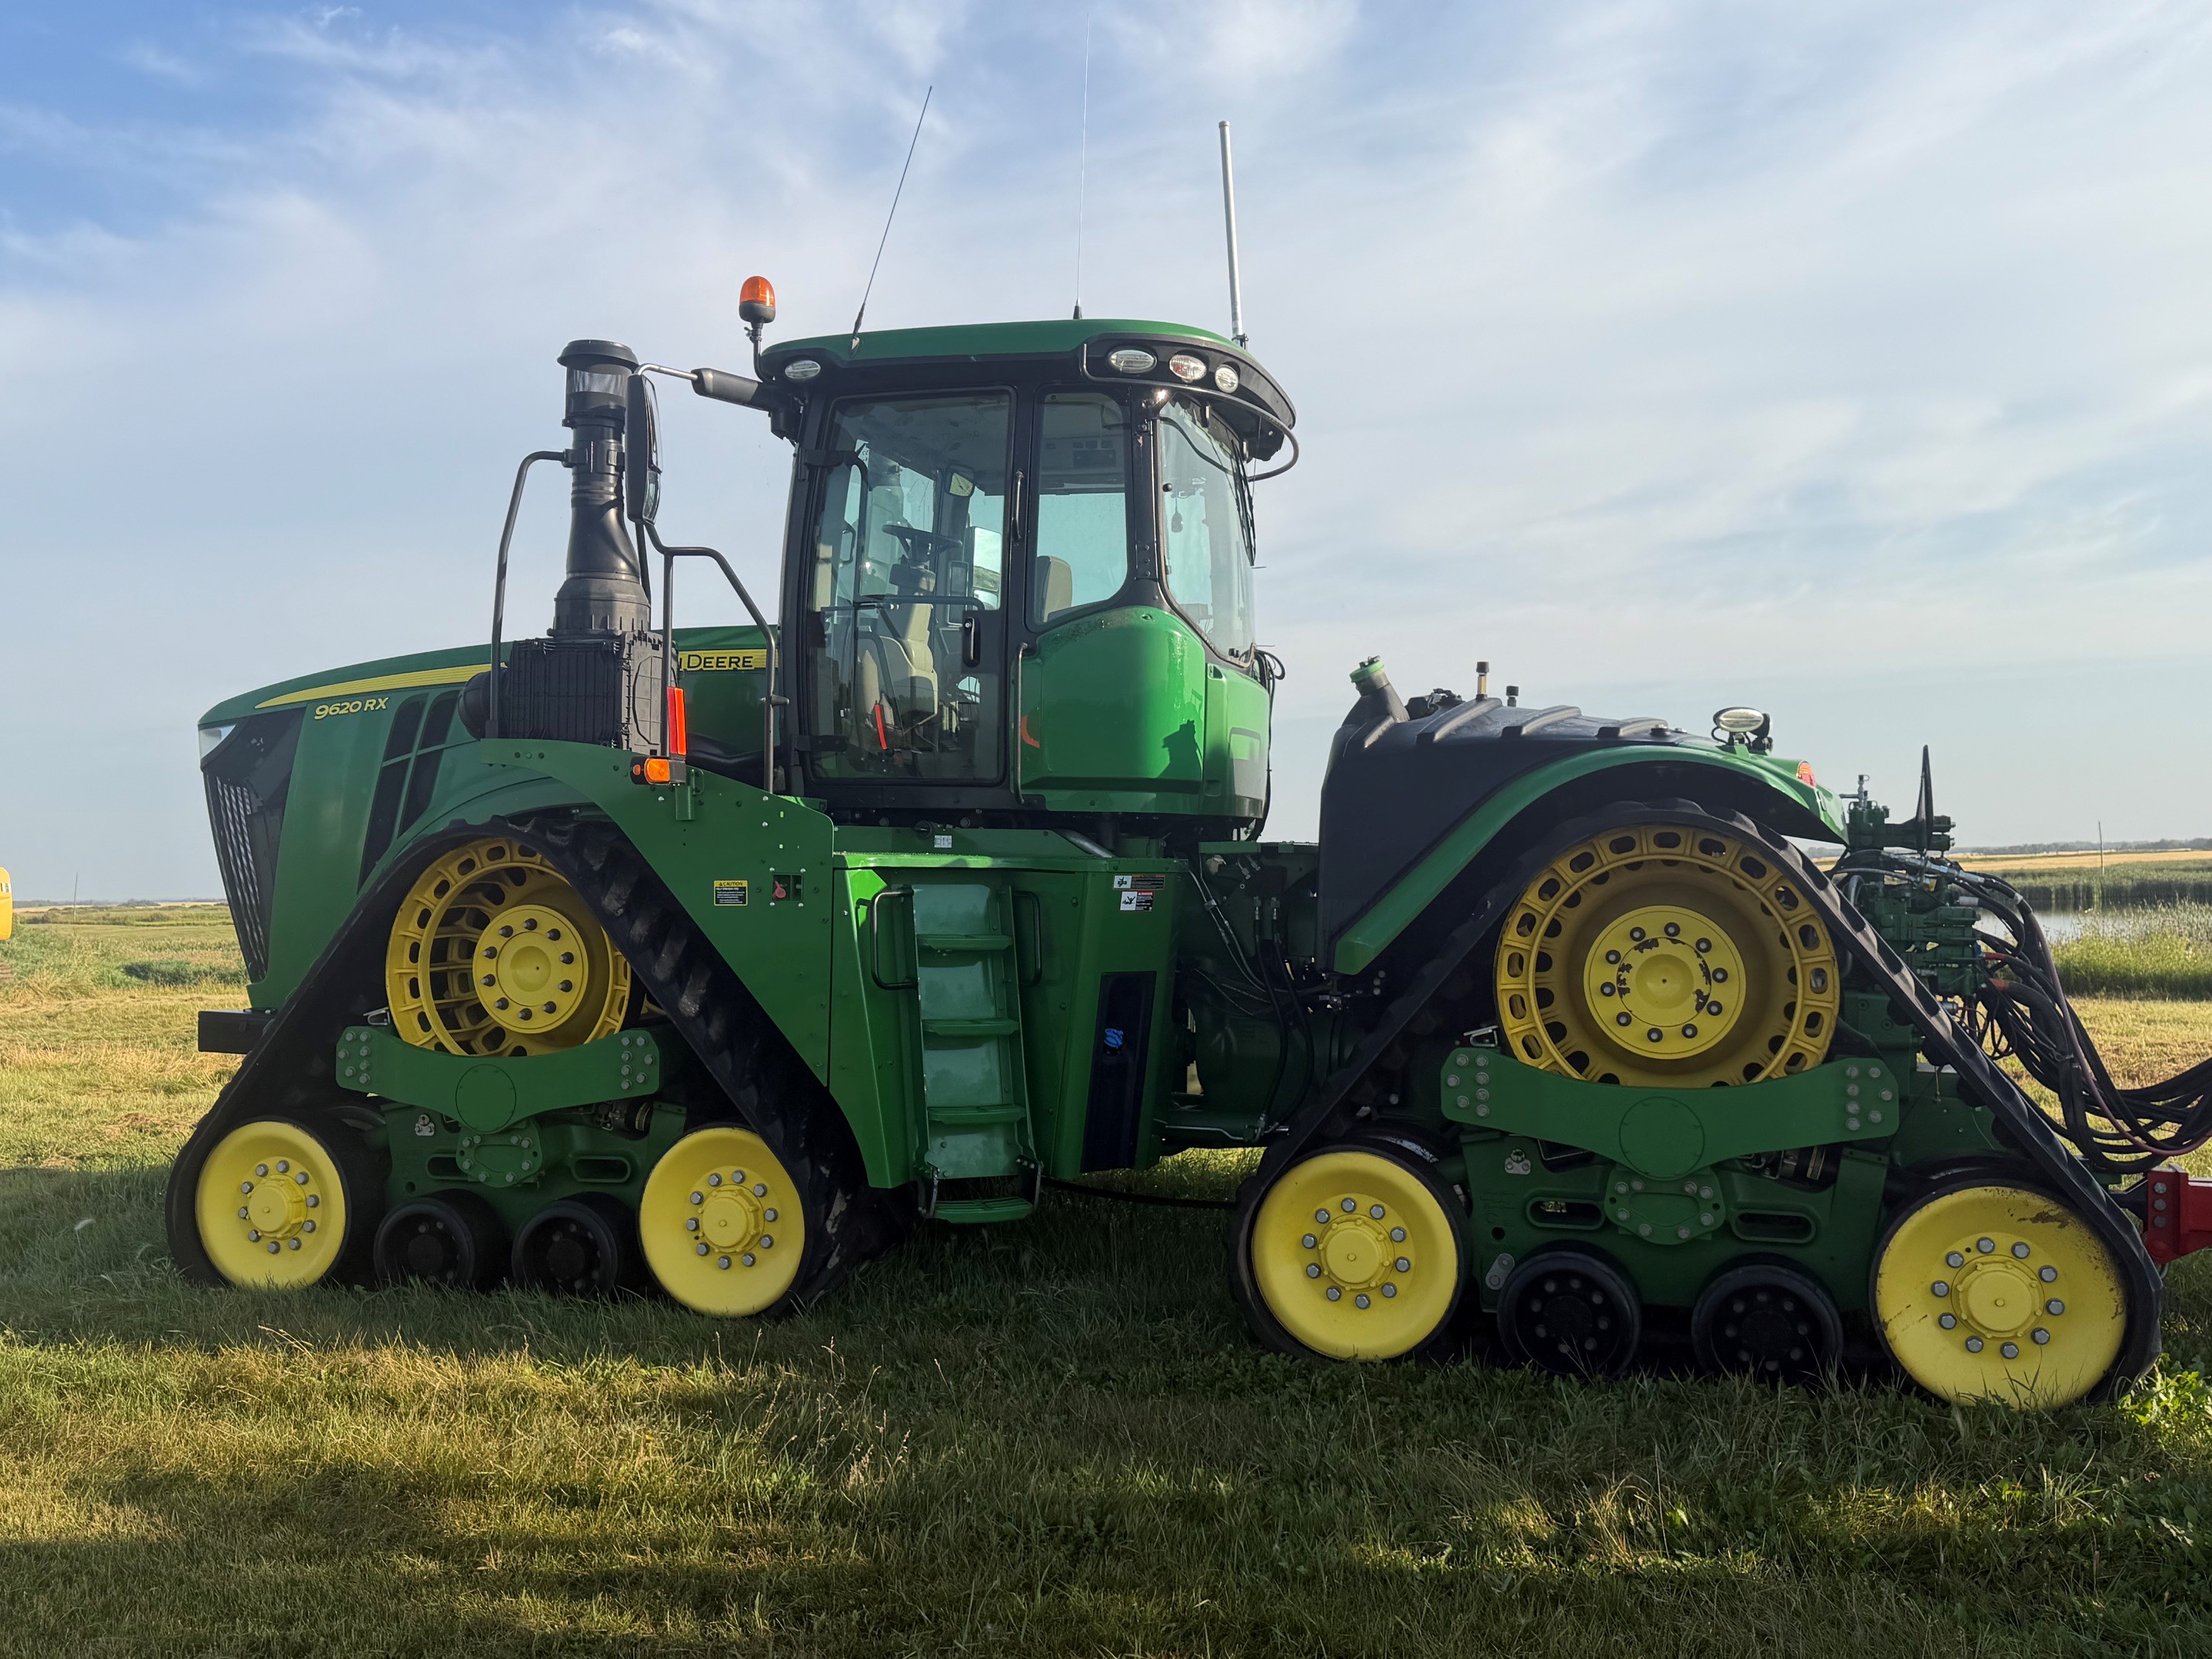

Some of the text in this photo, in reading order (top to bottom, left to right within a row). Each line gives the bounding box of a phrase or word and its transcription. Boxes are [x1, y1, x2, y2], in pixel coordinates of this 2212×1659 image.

[687, 654, 754, 668] DEERE
[314, 697, 389, 720] 9620 RX
